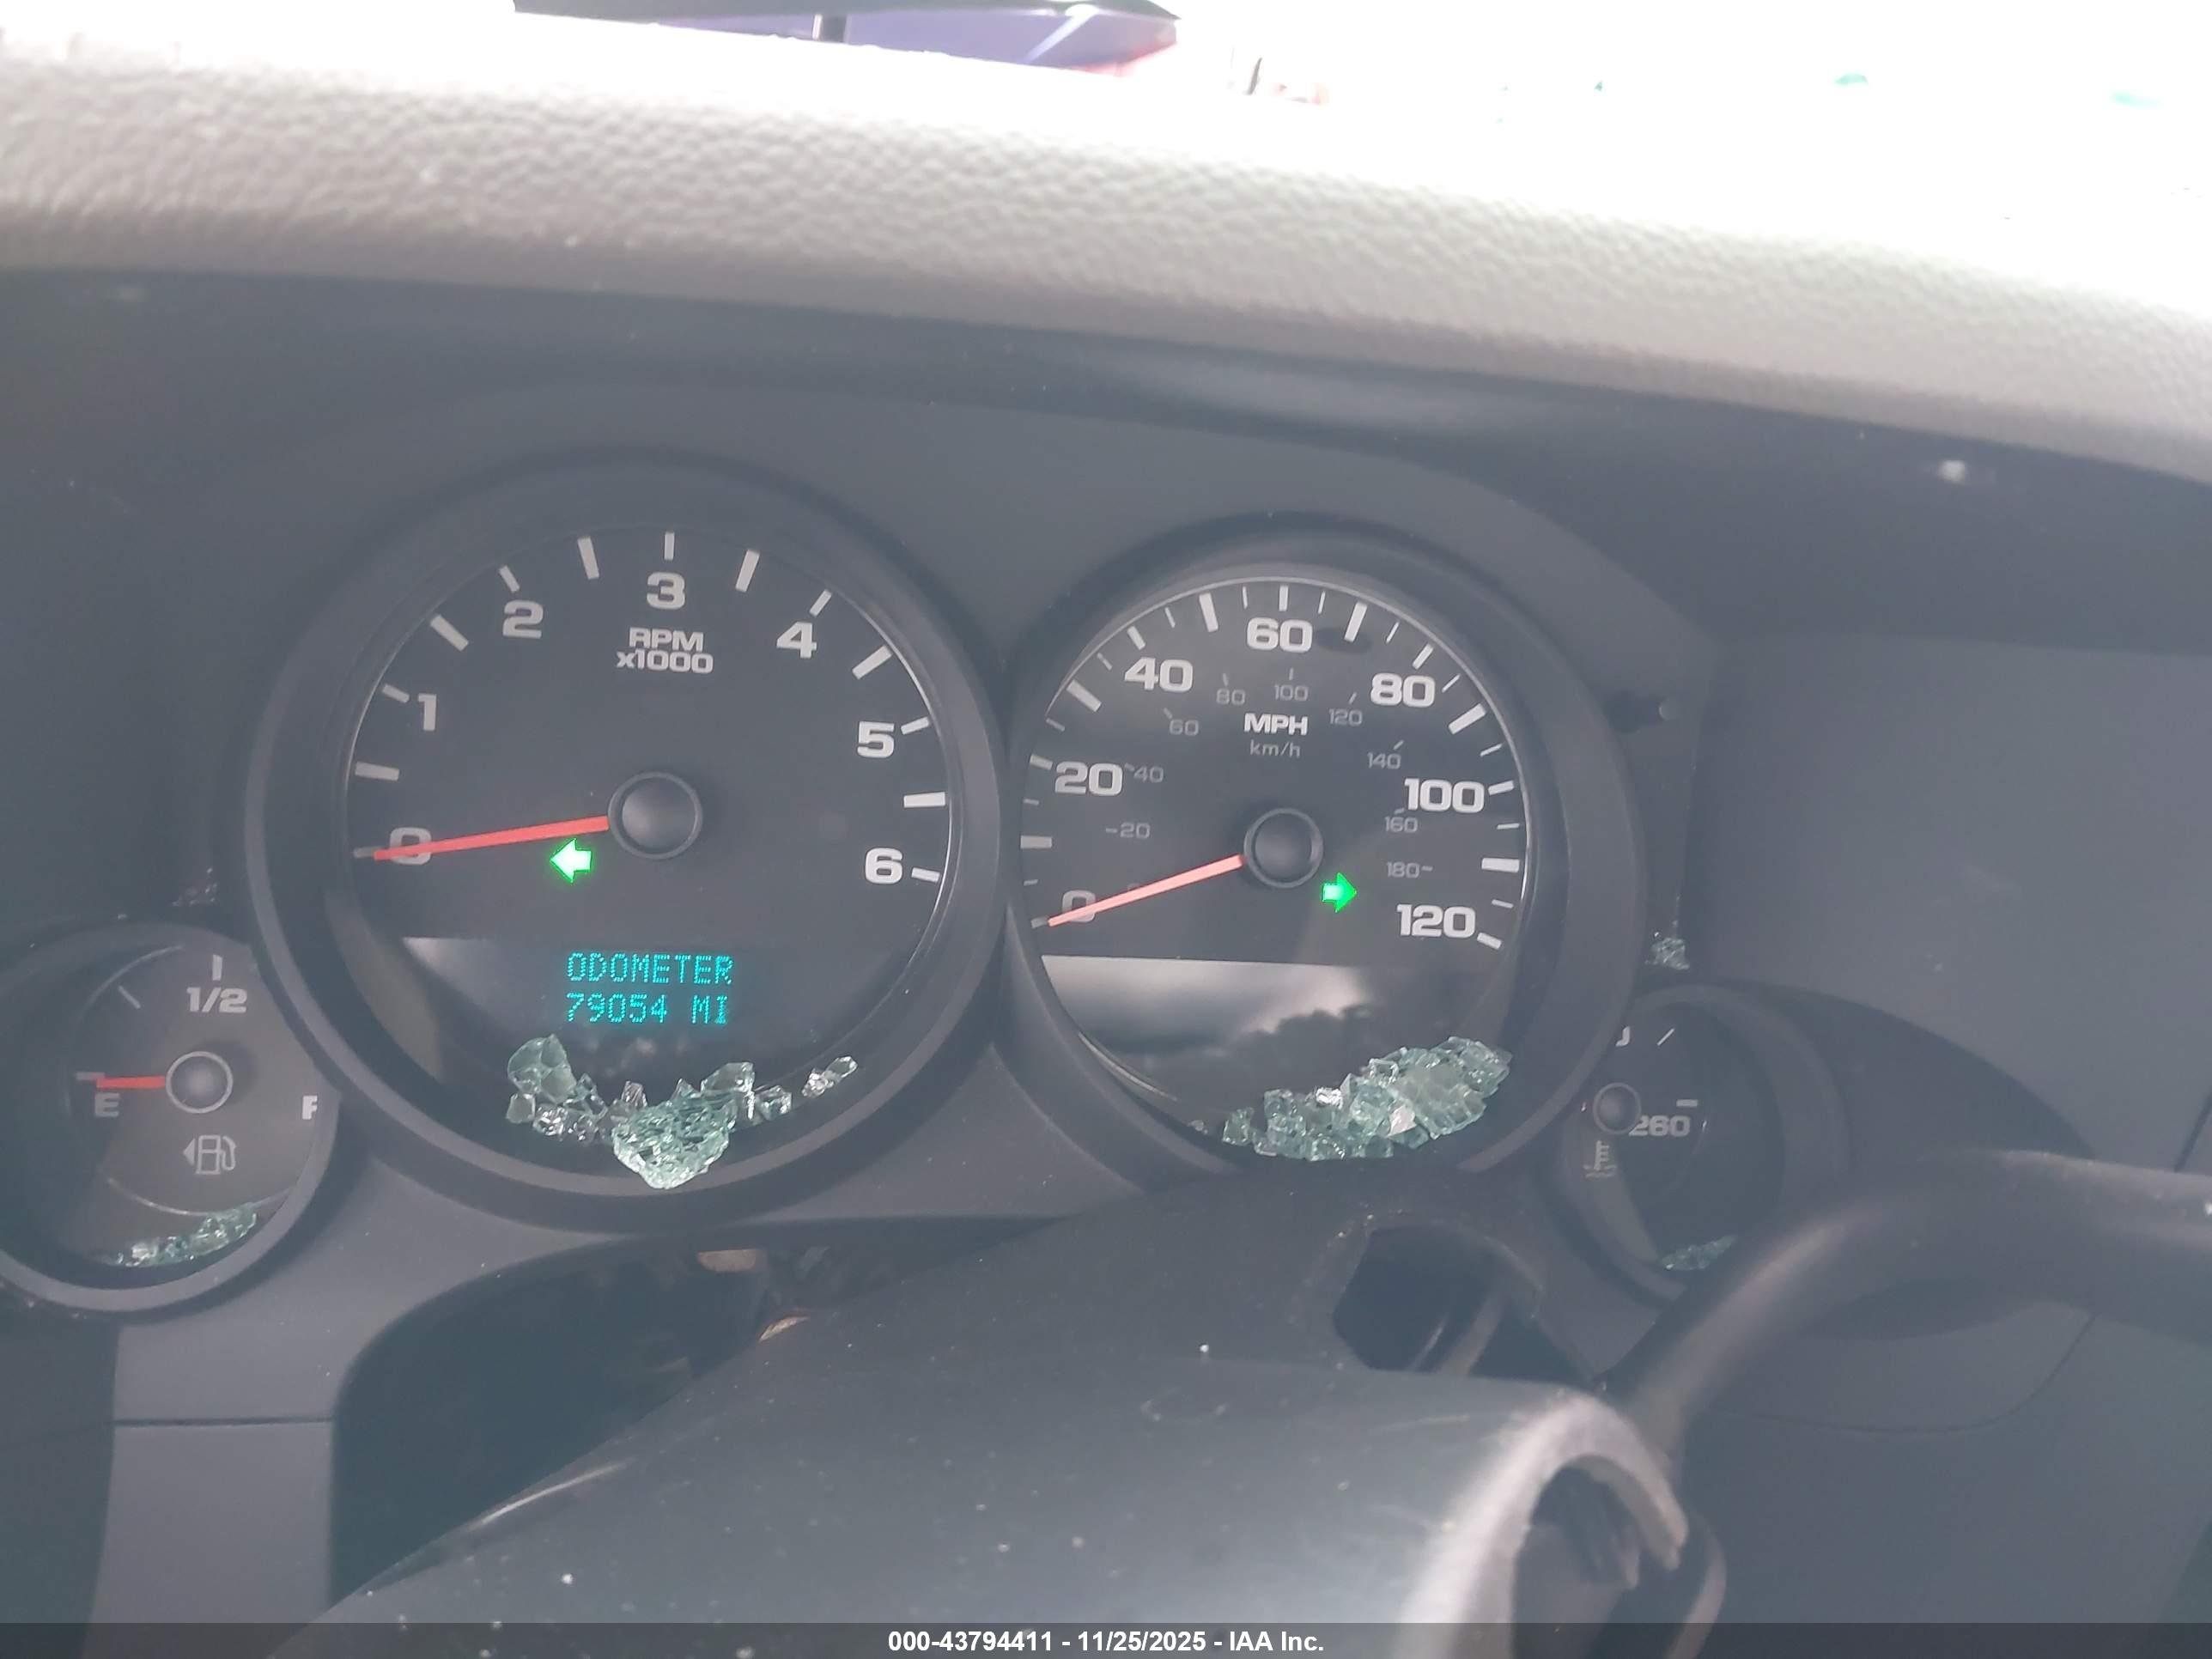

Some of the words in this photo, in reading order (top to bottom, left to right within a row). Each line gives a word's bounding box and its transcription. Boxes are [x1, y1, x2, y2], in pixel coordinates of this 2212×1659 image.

[646, 572, 686, 609] 3
[502, 601, 544, 638] 2
[629, 628, 704, 652] RPM
[775, 622, 817, 659] 4
[1246, 617, 1313, 653] 60
[616, 649, 714, 674] x1000
[1124, 658, 1194, 692] 40
[1216, 689, 1246, 705] 80
[1273, 686, 1309, 701] 100
[1370, 673, 1436, 708] 80
[417, 693, 437, 731] 1
[1243, 713, 1309, 735] MPH
[1328, 710, 1363, 726] 120
[857, 721, 896, 758] 5
[1170, 720, 1199, 736] 60
[1249, 740, 1301, 757] km/h
[1367, 753, 1401, 769] 140
[1054, 763, 1122, 796] 20
[1133, 767, 1164, 782] 40
[1403, 778, 1485, 813] 100
[1119, 823, 1150, 839] 20
[1384, 818, 1418, 833] 160
[388, 827, 432, 866] 0
[864, 848, 903, 885] 6
[1387, 863, 1420, 878] 180
[1061, 890, 1097, 922] 0
[1396, 904, 1476, 939] 120
[567, 953, 733, 983] ODOMETER
[186, 987, 247, 1013] 1/2
[566, 994, 666, 1024] 79054
[692, 994, 727, 1024] MI
[94, 1092, 119, 1116] E
[302, 1096, 318, 1120] F
[1628, 1115, 1690, 1136] 260
